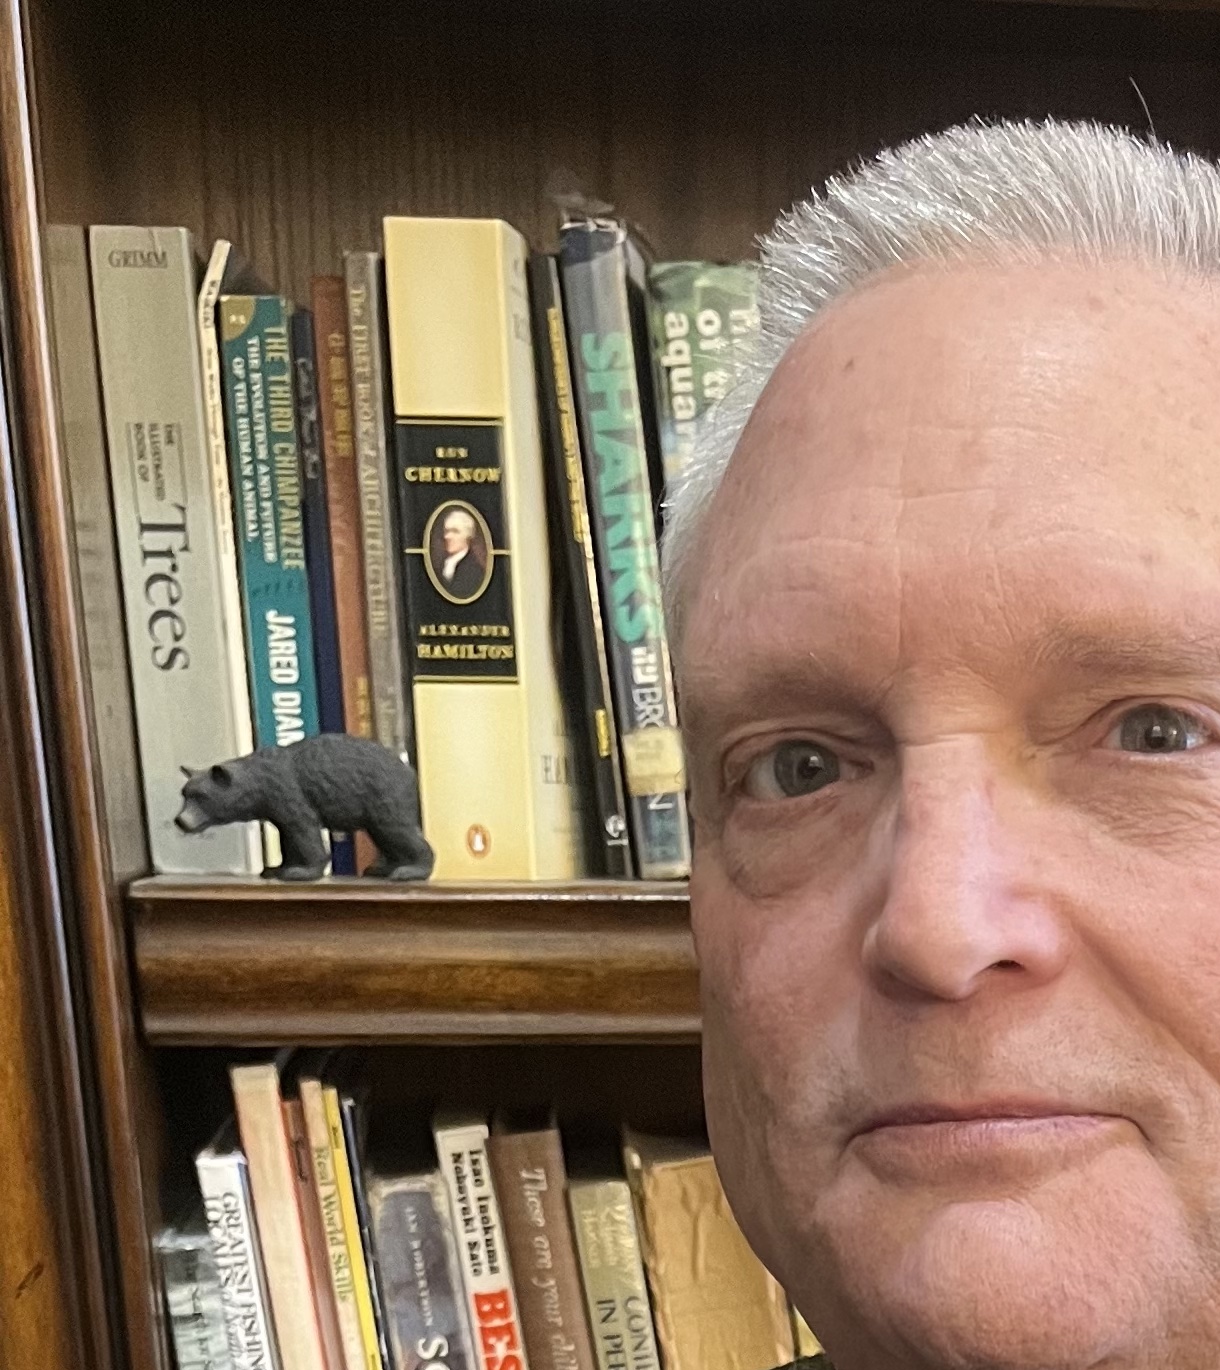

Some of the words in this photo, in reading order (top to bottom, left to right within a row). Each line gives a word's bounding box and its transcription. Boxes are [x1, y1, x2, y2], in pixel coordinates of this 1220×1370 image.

[108, 250, 168, 269] GRIMM
[232, 357, 245, 379] OF
[247, 336, 260, 369] THE
[264, 327, 288, 363] THE
[234, 382, 249, 415] THE
[251, 371, 268, 460] EVOLUTION
[269, 375, 292, 432] THIRD
[237, 417, 254, 478] HUMAN
[256, 462, 272, 498] AND
[272, 441, 306, 570] CHIMPANZEE
[580, 332, 662, 644] SHARKS
[242, 480, 259, 542] ANIMAL
[260, 500, 278, 563] FUTURE
[138, 503, 190, 672] Trees
[265, 609, 300, 684] JARED
[417, 644, 515, 660] HAMILTON
[419, 625, 510, 637] ALEXANDER
[321, 1194, 346, 1250] World
[520, 1167, 548, 1228] These
[222, 1191, 250, 1297] GREATEST
[533, 1236, 553, 1269] are
[331, 1252, 354, 1302] Skills
[531, 1275, 562, 1326] your
[596, 1299, 617, 1322] IN
